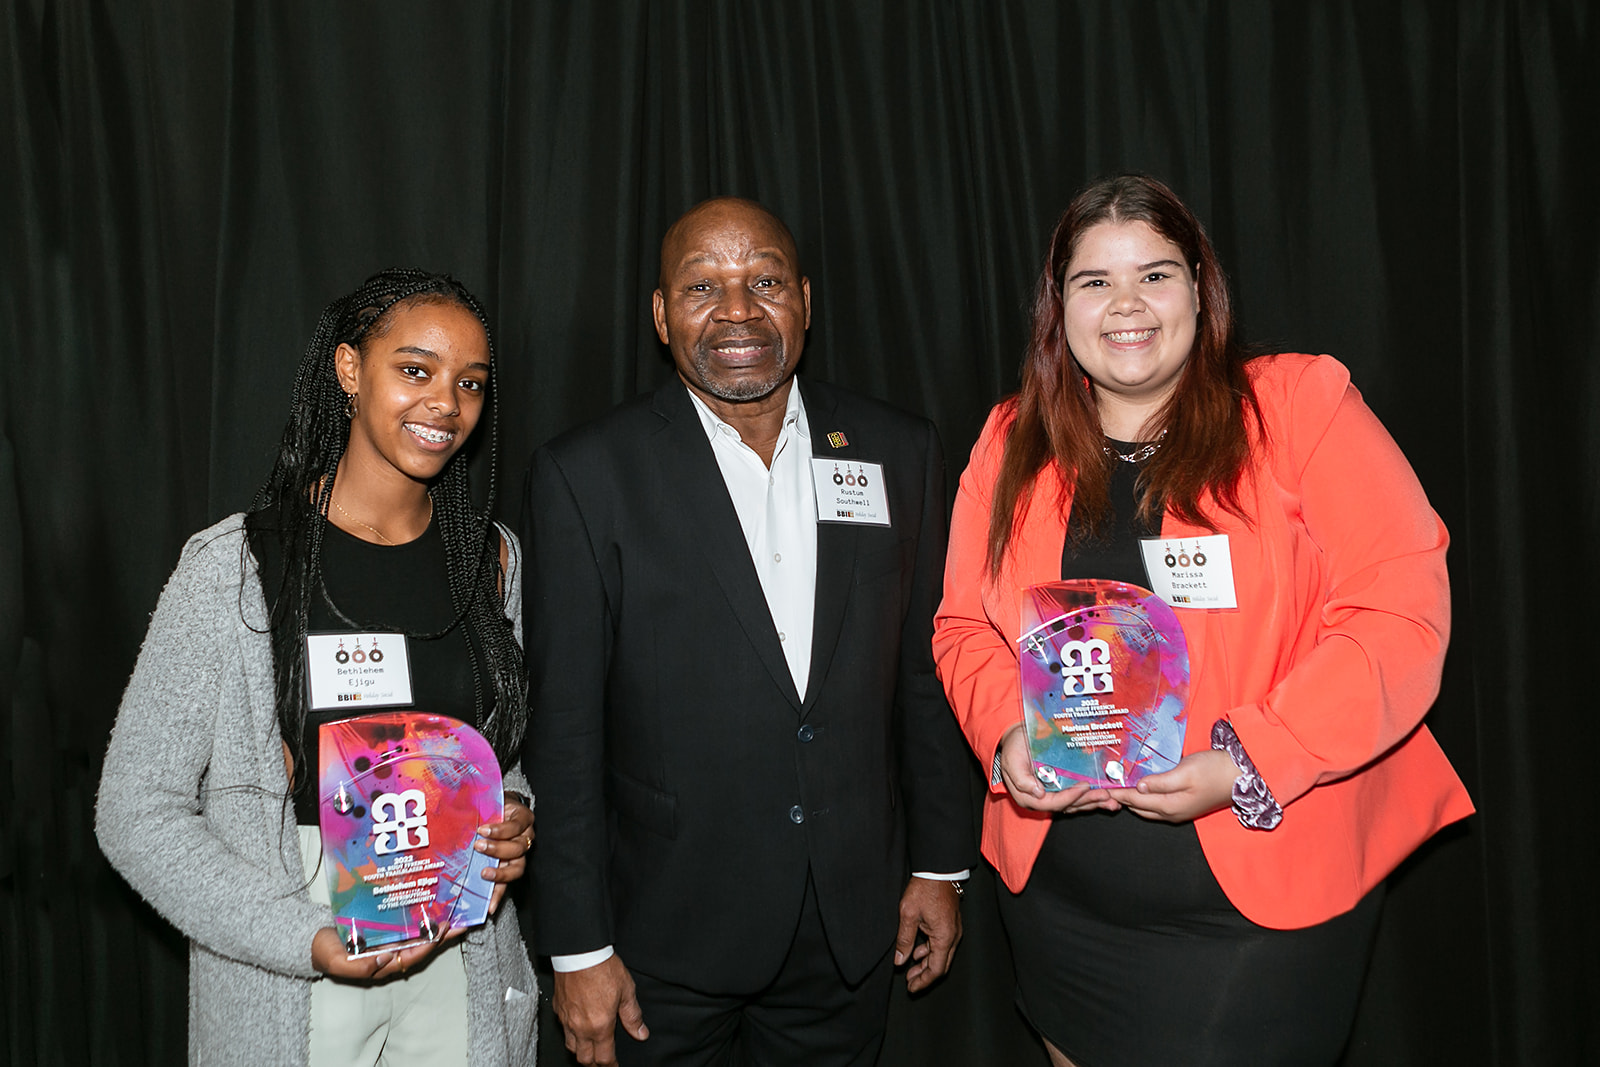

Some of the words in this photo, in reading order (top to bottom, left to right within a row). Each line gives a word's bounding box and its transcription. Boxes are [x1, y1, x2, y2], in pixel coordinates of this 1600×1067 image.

[836, 498, 870, 506] Southwell
[337, 667, 384, 675] Bethlehem
[348, 679, 375, 687] Ejigu
[337, 694, 353, 702] BBI
[1062, 724, 1090, 733] Marissa
[1090, 721, 1123, 731] Brackett
[1070, 734, 1116, 742] CONTRIBUTIONS
[394, 855, 413, 864] 2022
[363, 872, 385, 881] YOUTH
[424, 861, 445, 870] AWARD
[373, 881, 416, 896] Bethlehem
[417, 877, 438, 887] Ejigu
[382, 890, 430, 904] CONTRIBUTIONS
[400, 894, 436, 906] COMMUNITY
